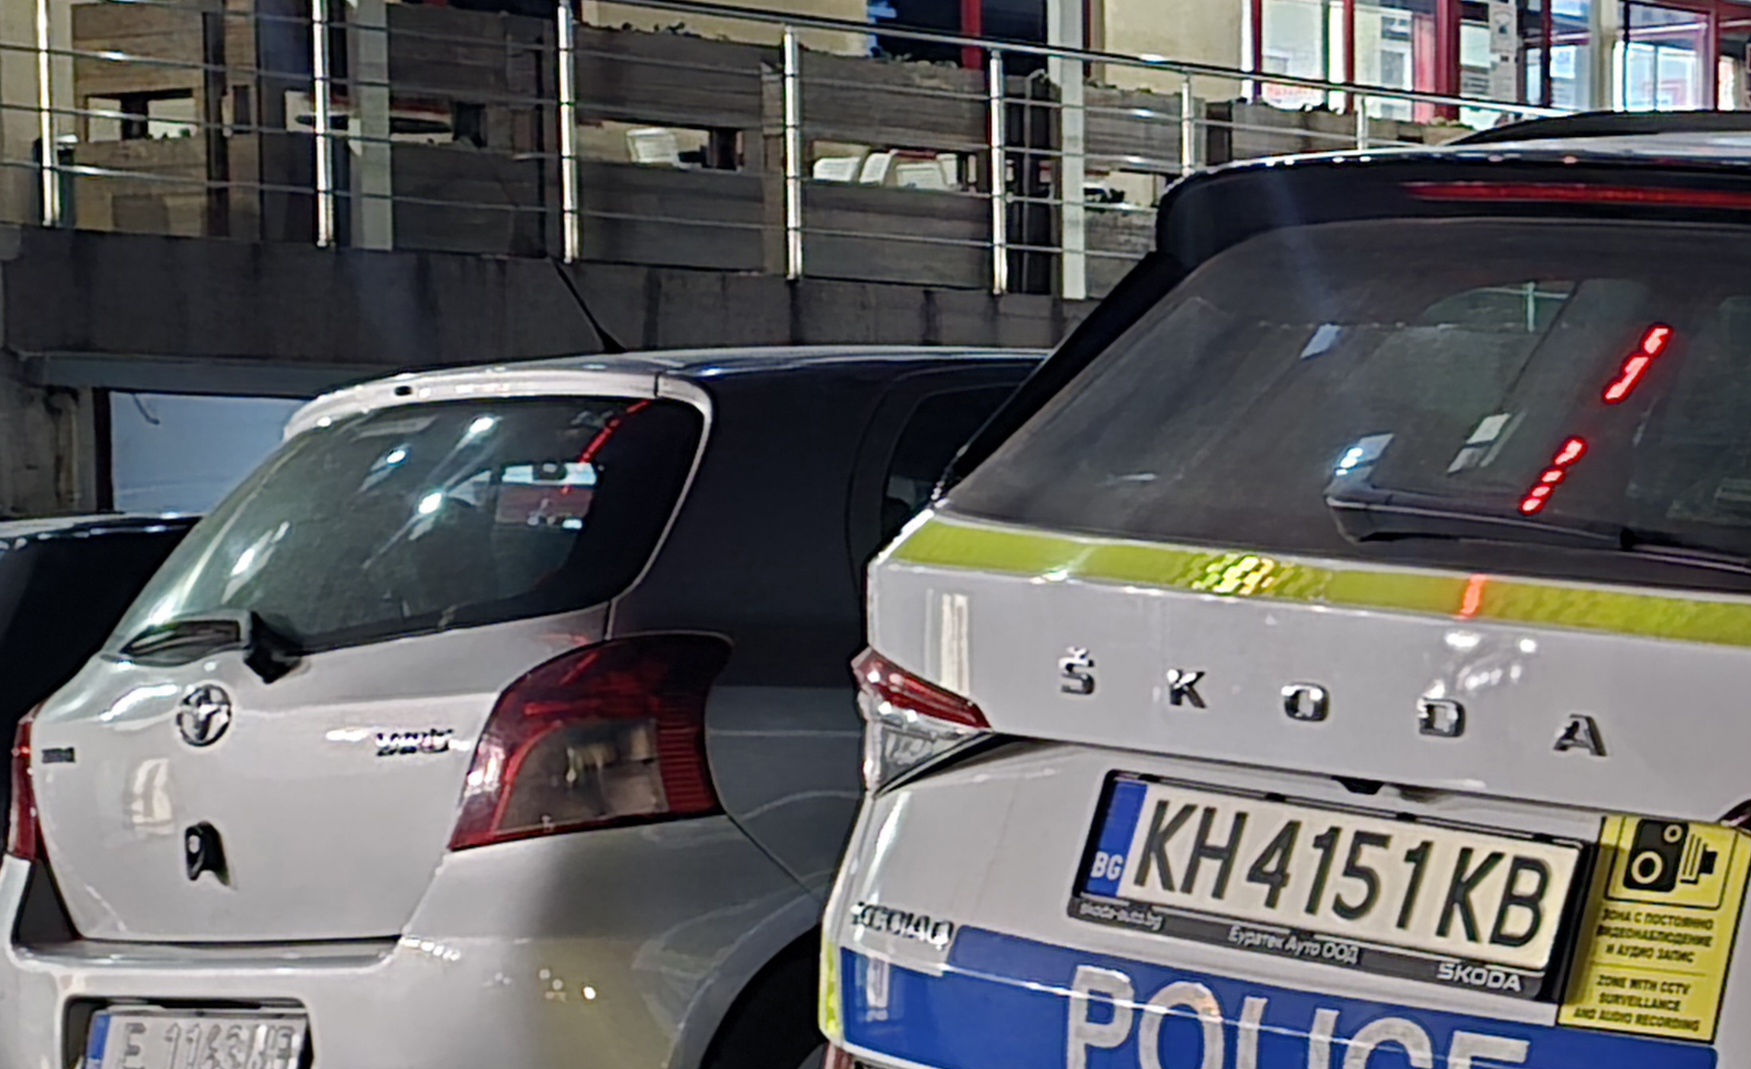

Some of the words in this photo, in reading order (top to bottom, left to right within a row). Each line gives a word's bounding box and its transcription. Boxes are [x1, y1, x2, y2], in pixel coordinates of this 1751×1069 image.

[1058, 646, 1607, 757] ŠKODA
[1090, 852, 1125, 880] BG
[1633, 911, 1643, 923] С
[1284, 934, 1322, 956] Ауто
[1321, 942, 1360, 965] ООД
[1659, 980, 1693, 996] CCTV
